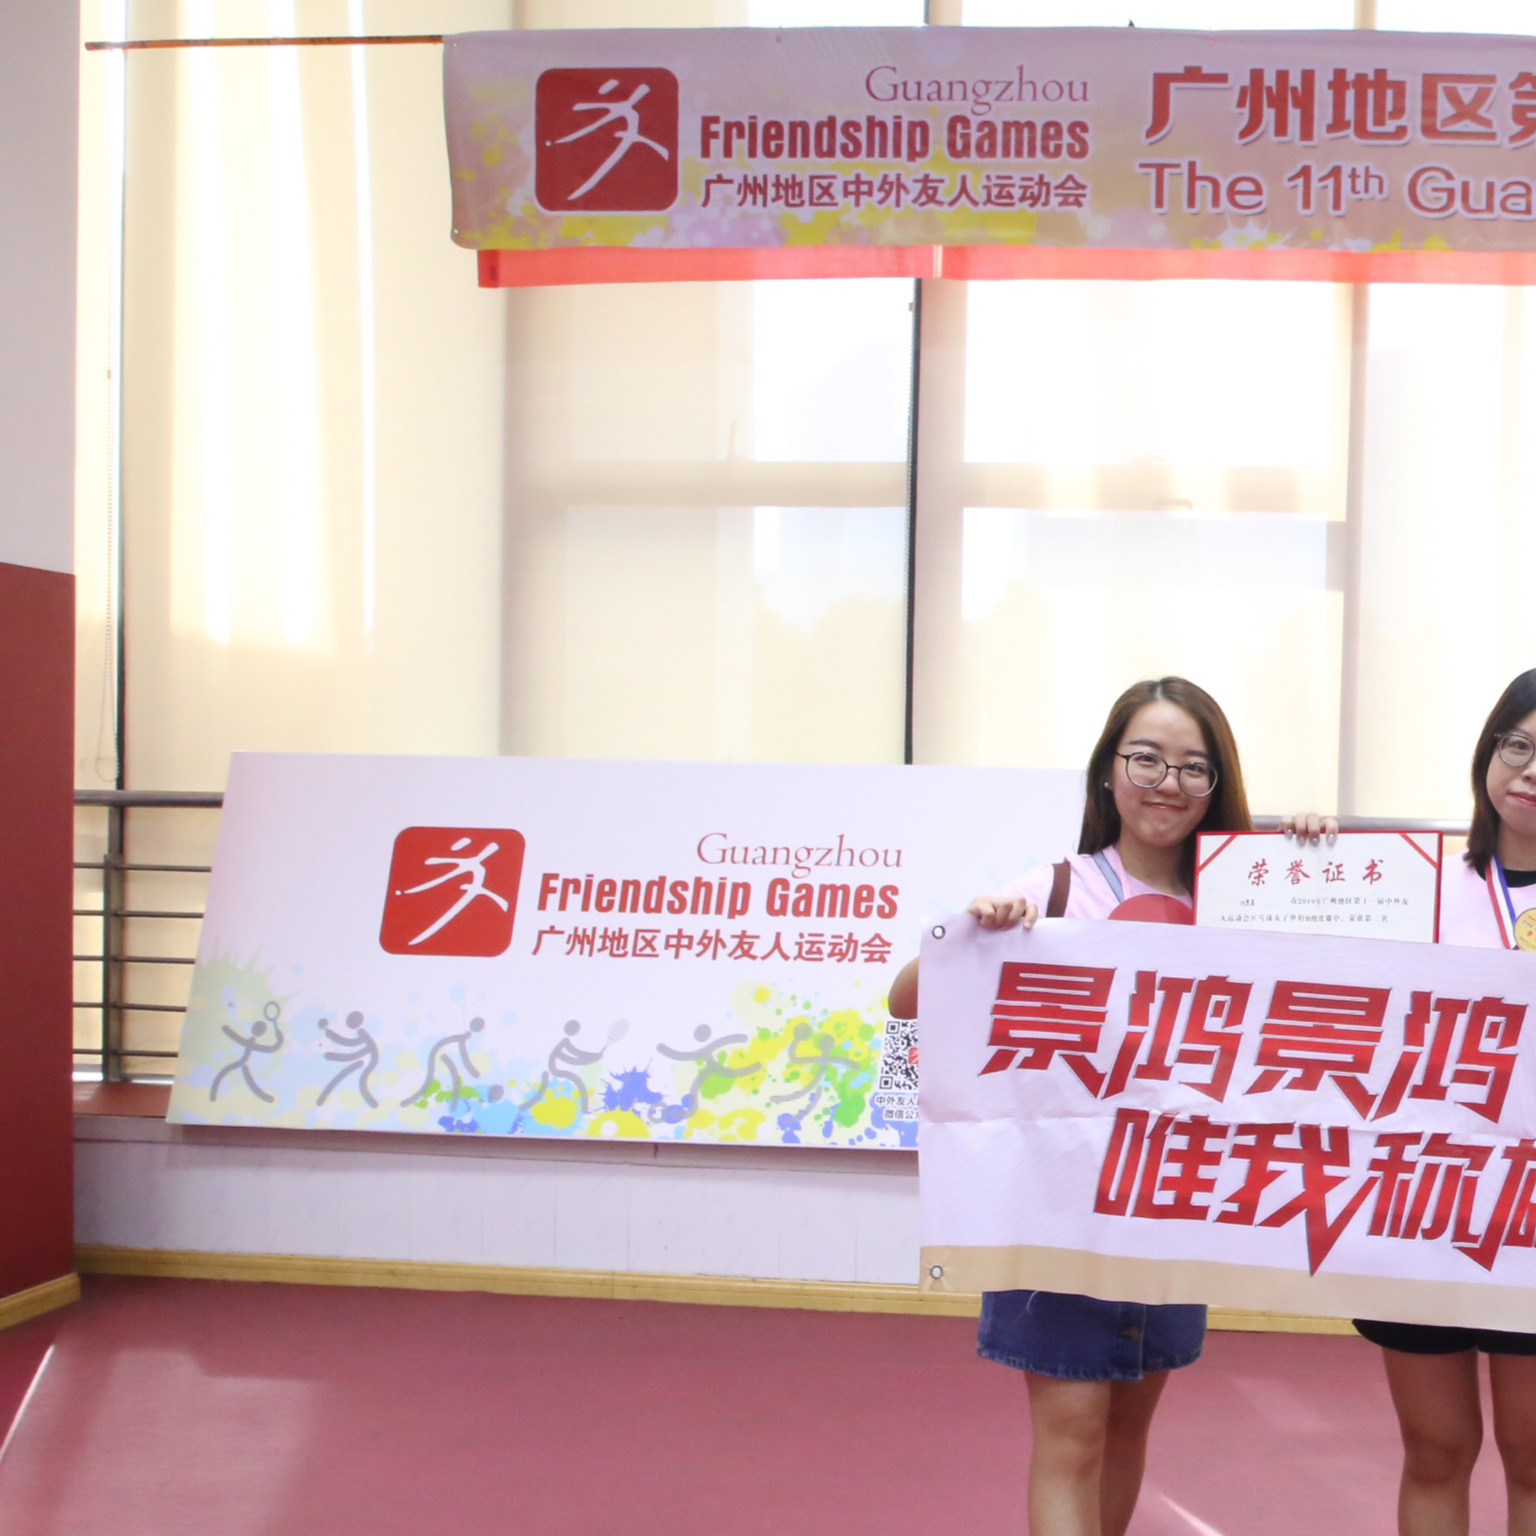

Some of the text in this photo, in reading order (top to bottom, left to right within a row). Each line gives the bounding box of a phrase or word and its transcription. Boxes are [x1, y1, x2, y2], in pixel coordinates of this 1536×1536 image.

[865, 65, 1089, 115] Guangzhou
[700, 115, 1089, 162] Friendship Games
[700, 173, 1088, 209] 广州地区中外友人运动会
[1140, 162, 1265, 213] The
[1288, 164, 1386, 213] 11th
[696, 832, 903, 877] Guangzhou
[1248, 858, 1385, 887] 荣誉证书
[537, 872, 899, 919] Friendship Games
[532, 926, 893, 963] 广州地区中外友人运动会
[978, 961, 1528, 1123] 景鸿景鸿
[876, 1096, 919, 1107] 中外友人
[885, 1109, 919, 1119] 微信公
